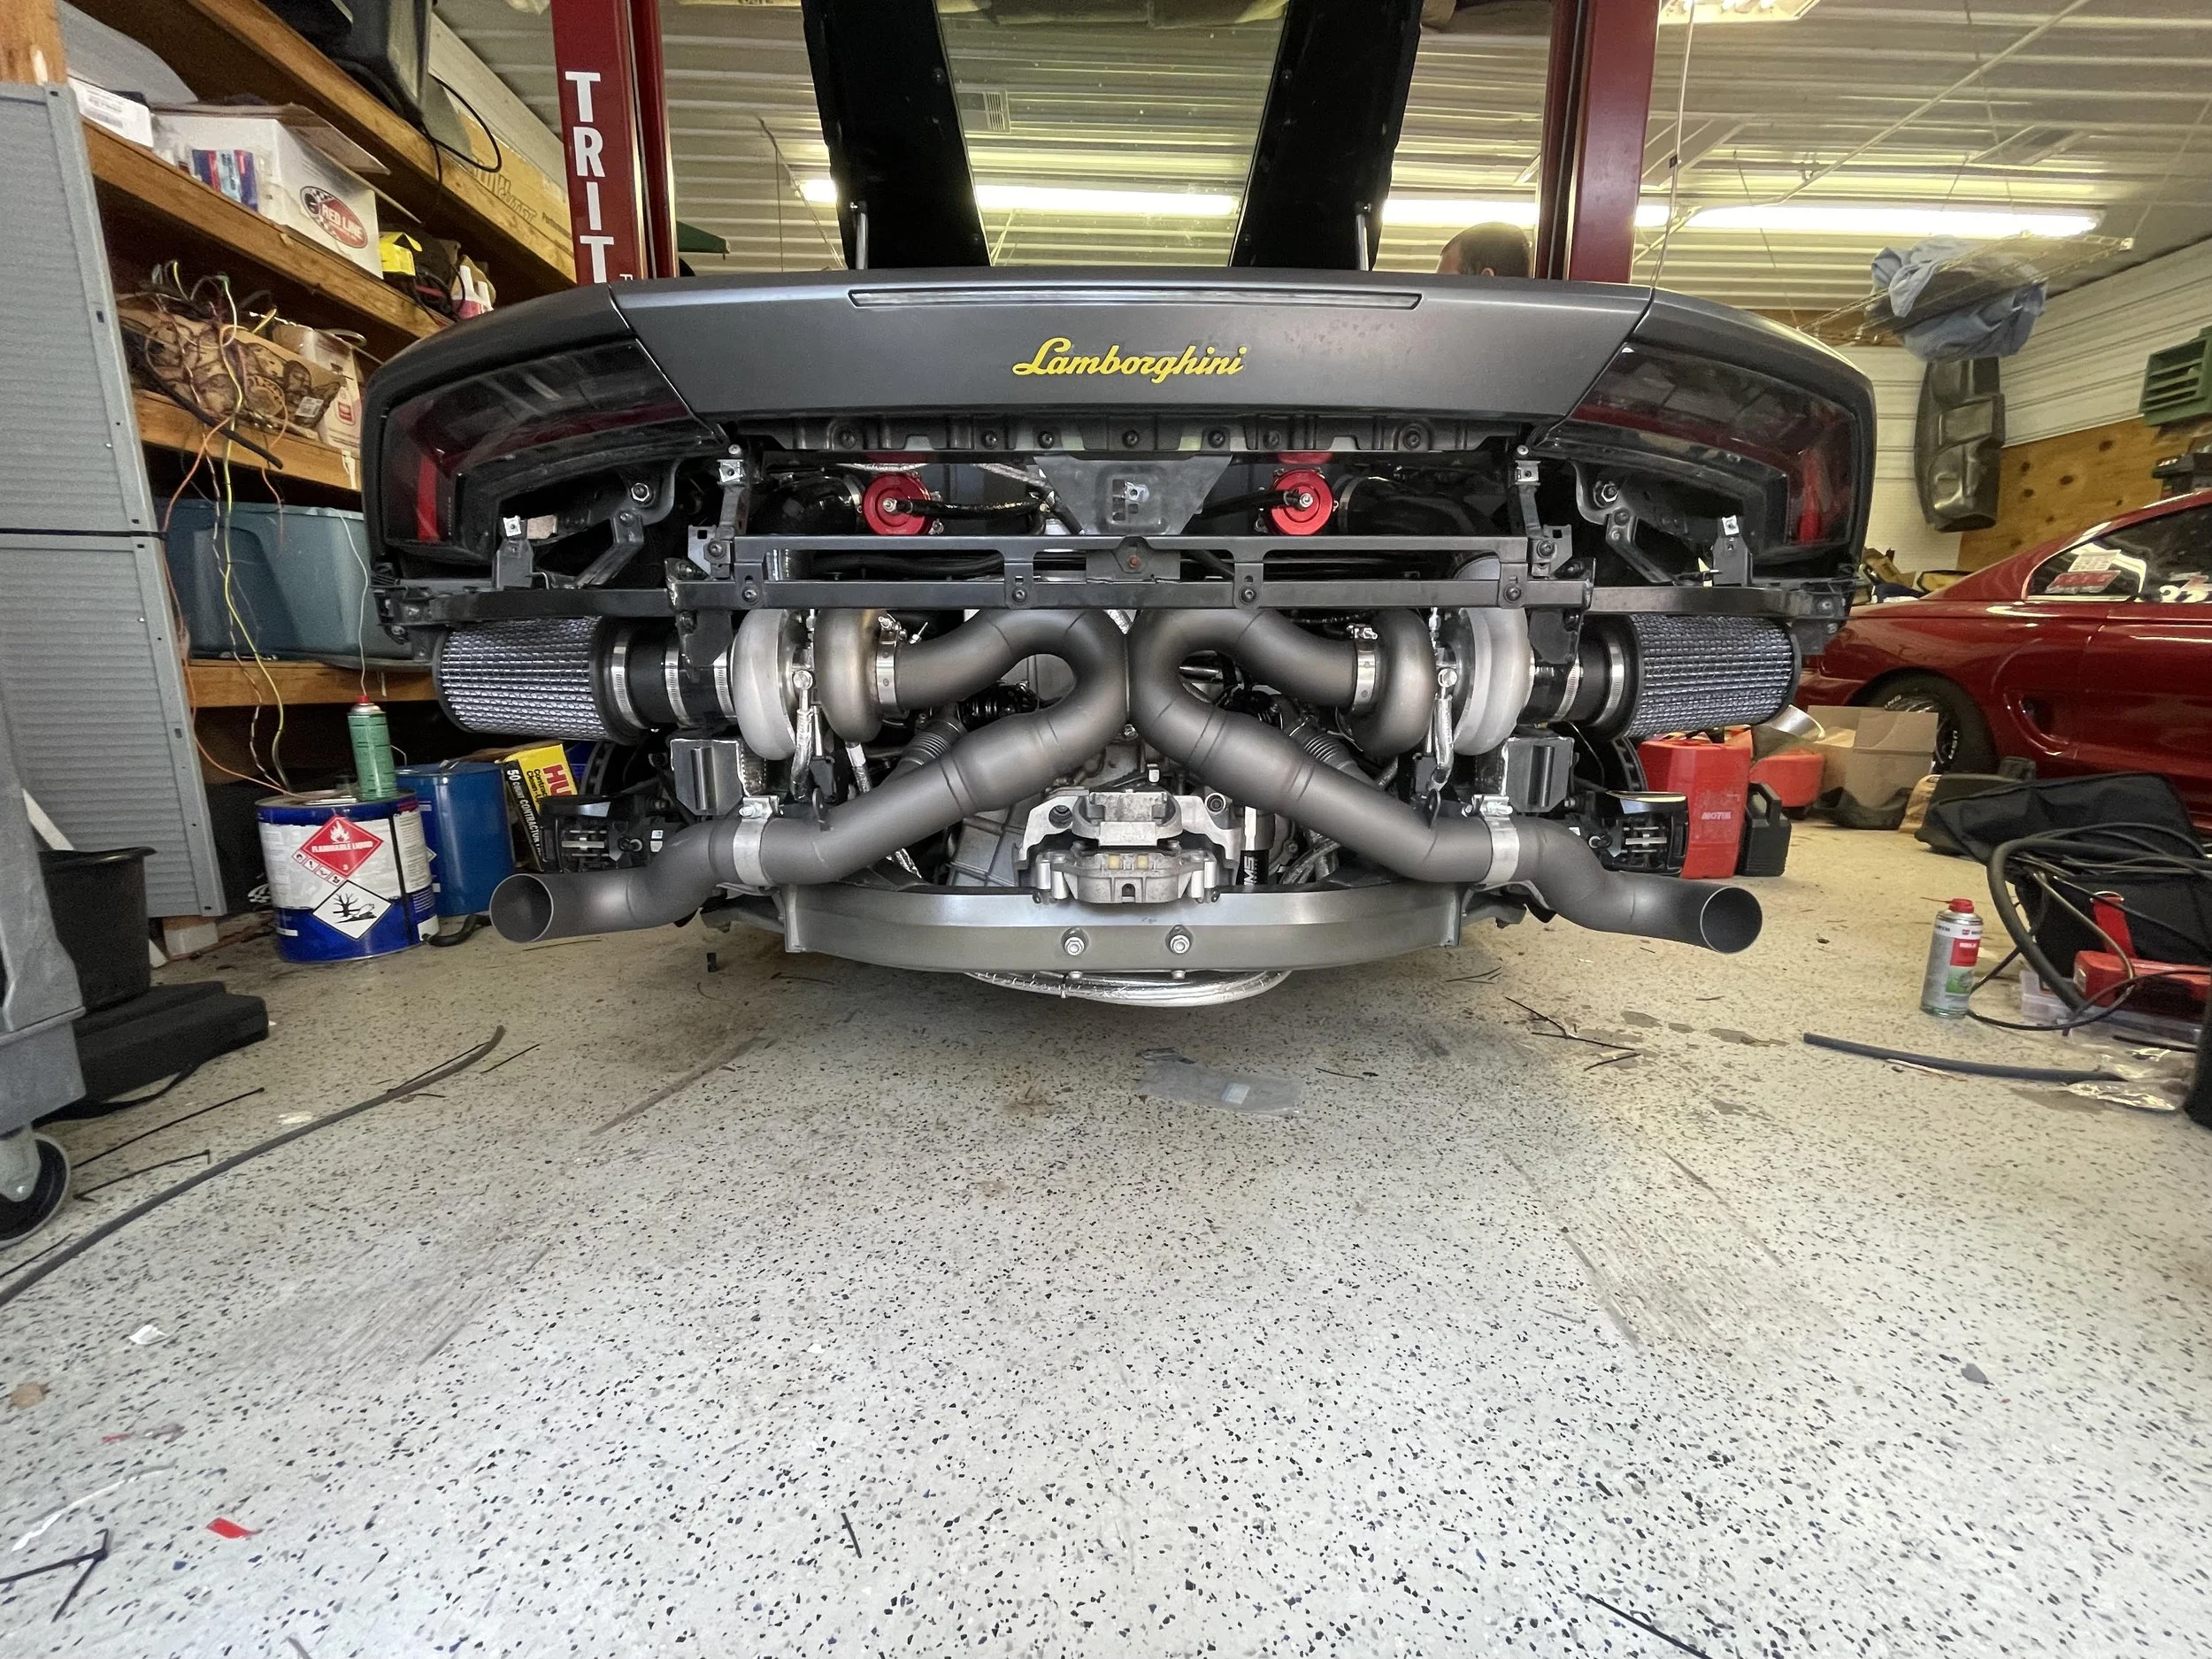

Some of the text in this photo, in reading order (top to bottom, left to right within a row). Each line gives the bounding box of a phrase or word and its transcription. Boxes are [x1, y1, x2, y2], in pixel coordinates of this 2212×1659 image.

[565, 71, 614, 283] TRIT
[321, 203, 342, 227] RED
[1011, 337, 1248, 384] Lamborghini
[507, 769, 522, 781] 50
[534, 768, 548, 796] Contrac
[542, 764, 573, 795] HU
[311, 841, 373, 853] FLAMMABLE LIQUID
